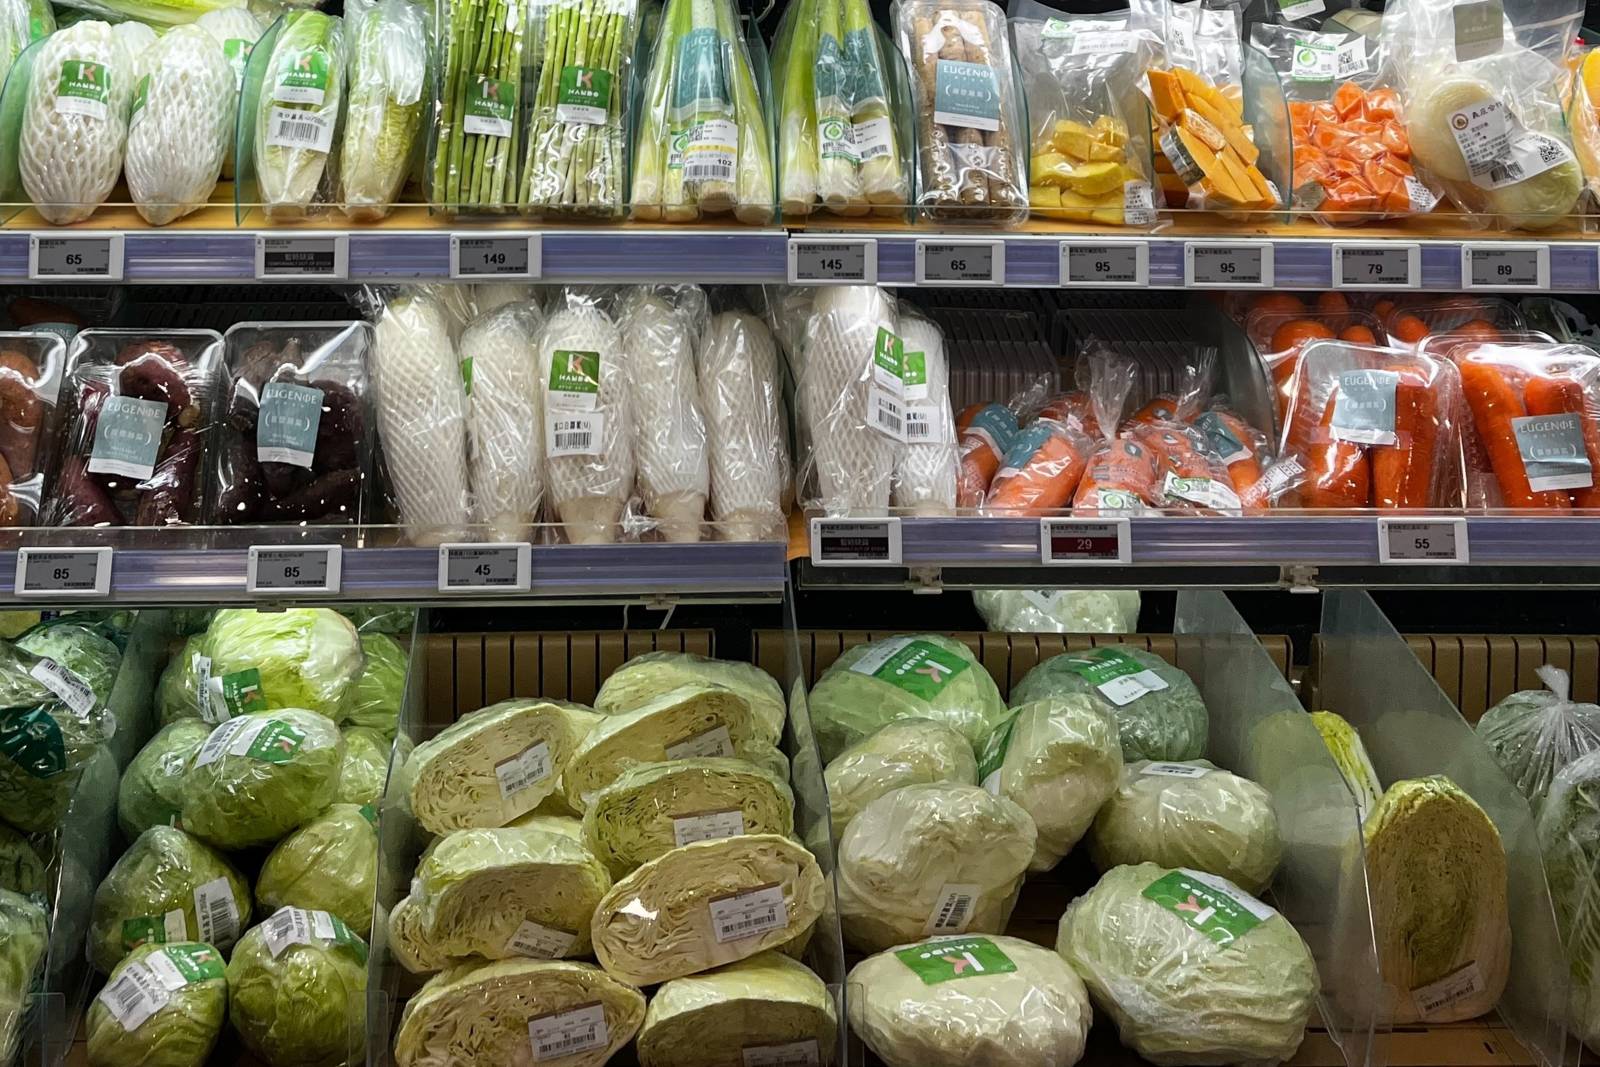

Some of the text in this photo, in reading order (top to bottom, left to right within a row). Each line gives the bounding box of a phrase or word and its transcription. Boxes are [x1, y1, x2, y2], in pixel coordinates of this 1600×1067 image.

[716, 158, 733, 166] 102
[65, 254, 82, 265] 65
[482, 253, 506, 264] 149
[820, 258, 843, 270] 145
[950, 259, 967, 271] 65
[1095, 261, 1111, 272] 95
[1220, 262, 1236, 274] 95
[1367, 263, 1383, 275] 79
[1497, 264, 1513, 276] 89
[1077, 538, 1093, 550] 29
[1414, 538, 1430, 550] 55
[53, 567, 70, 580] 85
[284, 566, 300, 578] 85
[474, 564, 491, 576] 45
[1174, 895, 1217, 925] K
[943, 951, 985, 974] K
